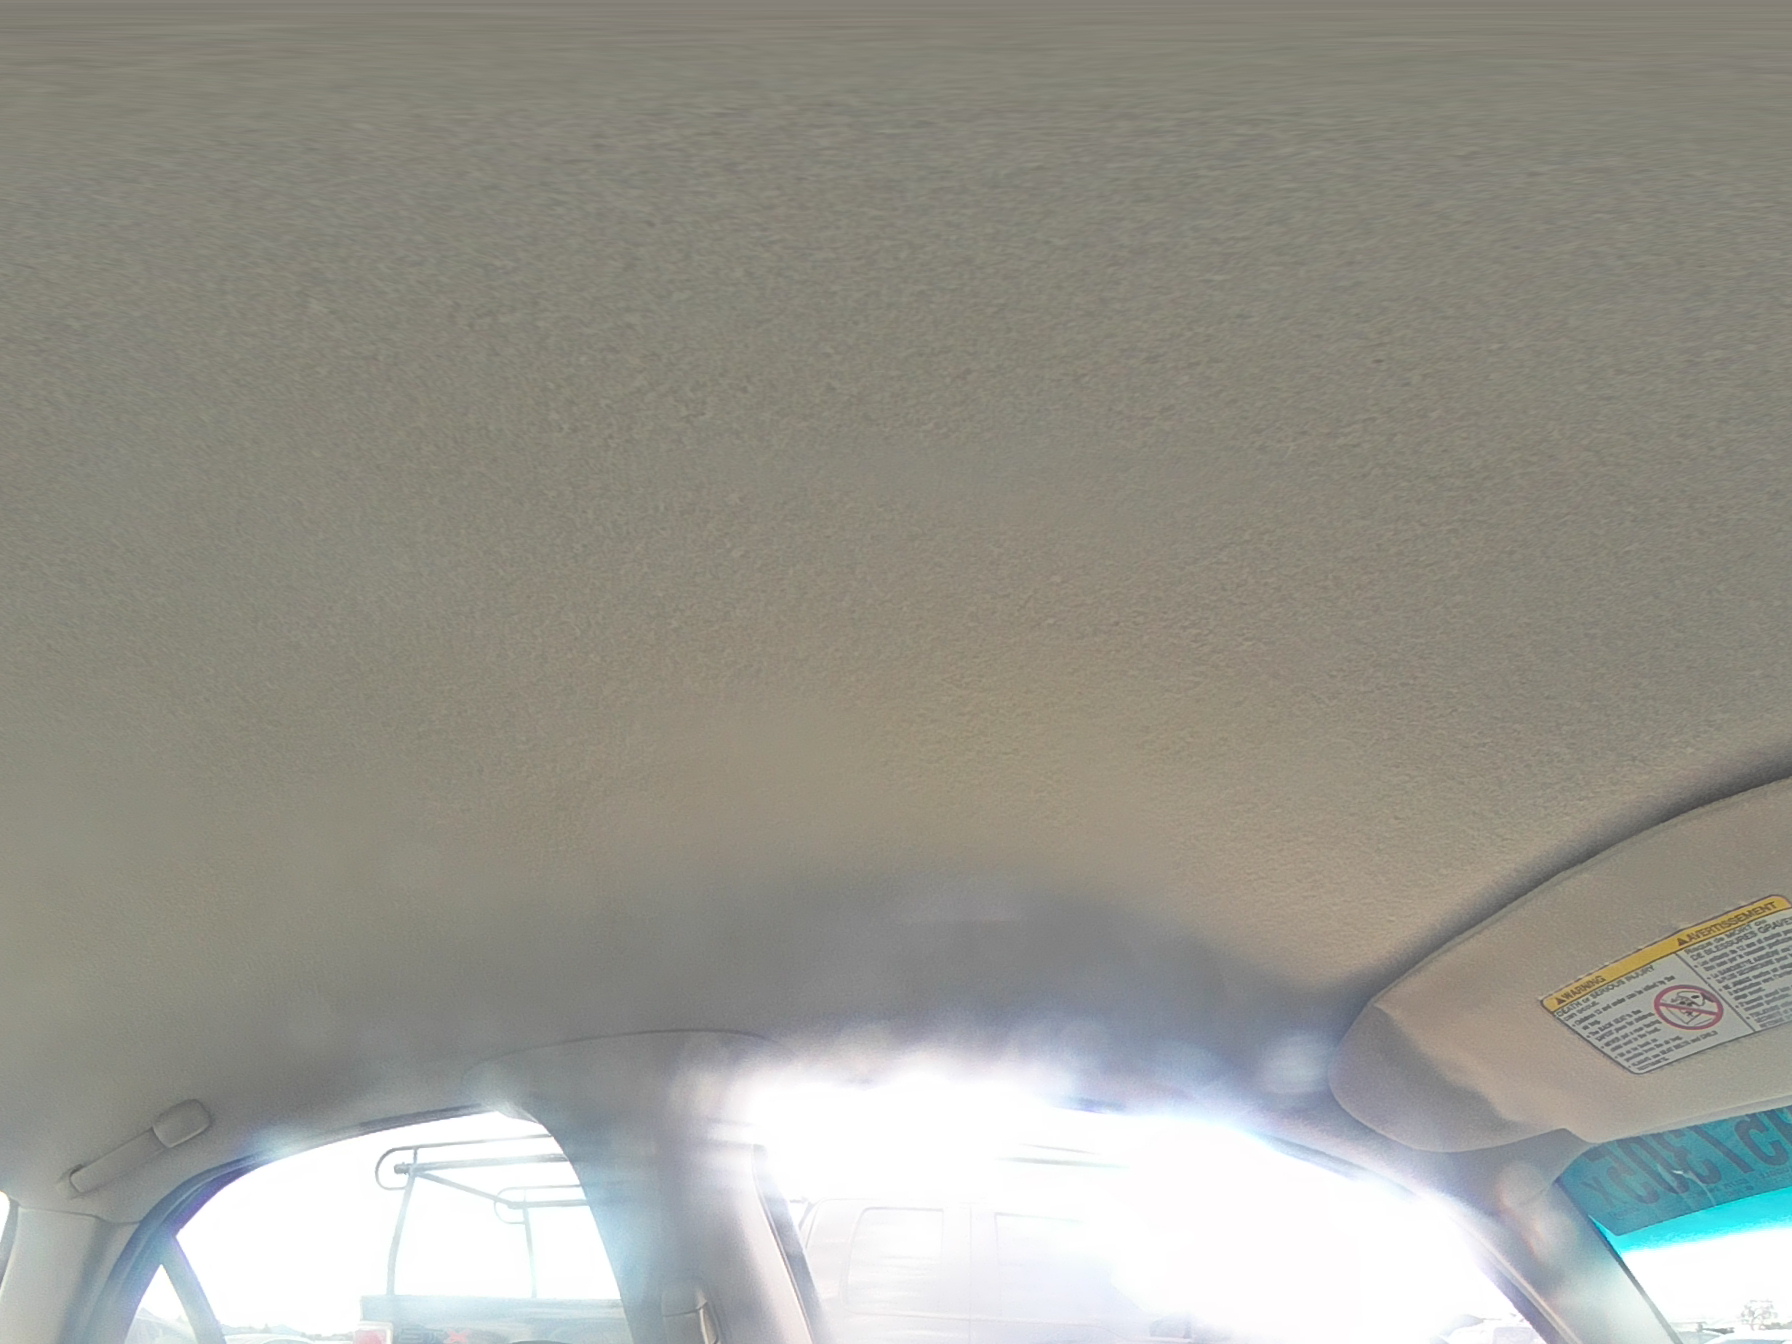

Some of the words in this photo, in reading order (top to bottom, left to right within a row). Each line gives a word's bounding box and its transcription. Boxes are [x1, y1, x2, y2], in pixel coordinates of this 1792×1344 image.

[1685, 900, 1777, 942] AVERTISSEMENT
[1554, 1000, 1582, 1017] DEATH
[1588, 978, 1626, 999] SERIOUS
[1560, 974, 1606, 1000] WARNING
